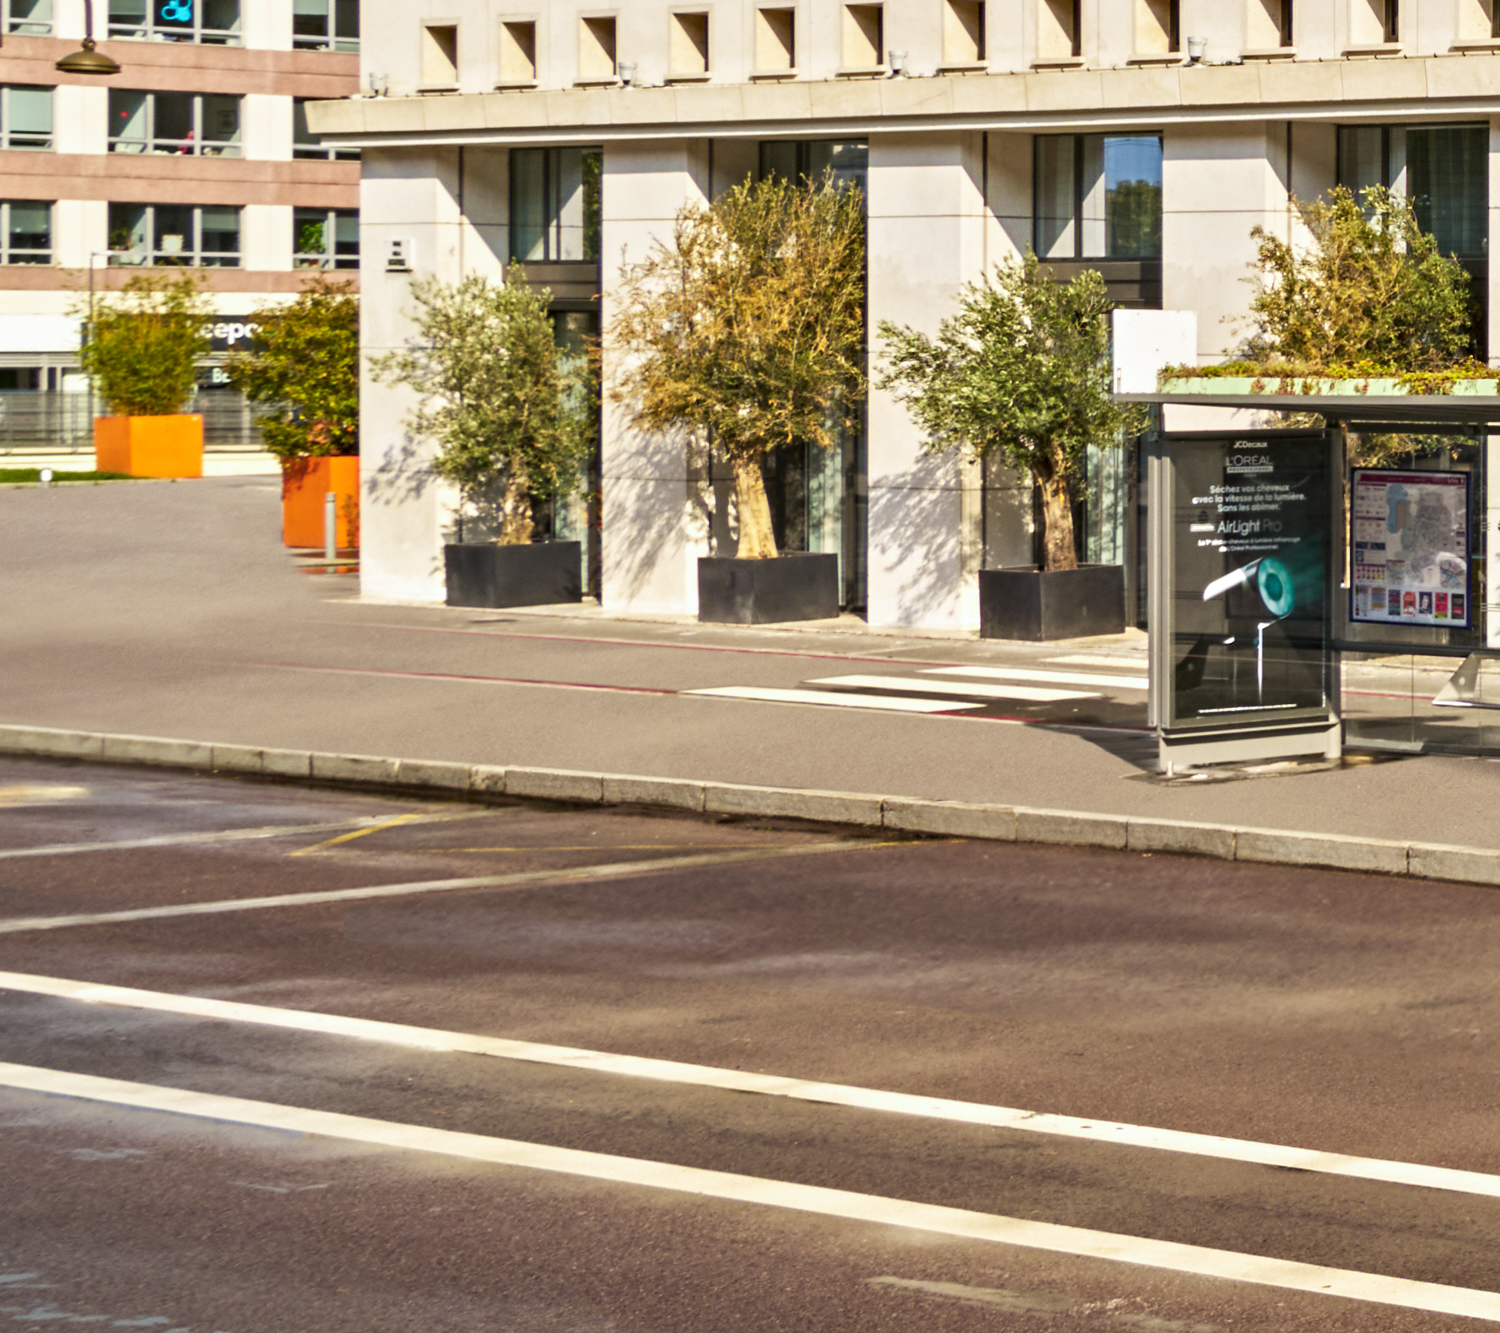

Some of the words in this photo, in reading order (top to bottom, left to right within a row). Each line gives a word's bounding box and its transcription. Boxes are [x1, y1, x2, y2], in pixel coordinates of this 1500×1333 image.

[1233, 440, 1269, 449] JCDecaux
[1226, 455, 1273, 466] L'ORÉAL
[1209, 485, 1241, 494] Séchez
[1191, 496, 1214, 505] avec
[1215, 495, 1224, 503] la
[1225, 494, 1253, 502] vitesse
[1254, 494, 1265, 502] de
[1274, 493, 1307, 501] lumière.
[1217, 504, 1238, 512] Sans
[1238, 503, 1250, 511] les
[1217, 520, 1260, 536] AirLight
[1263, 519, 1283, 532] Pro
